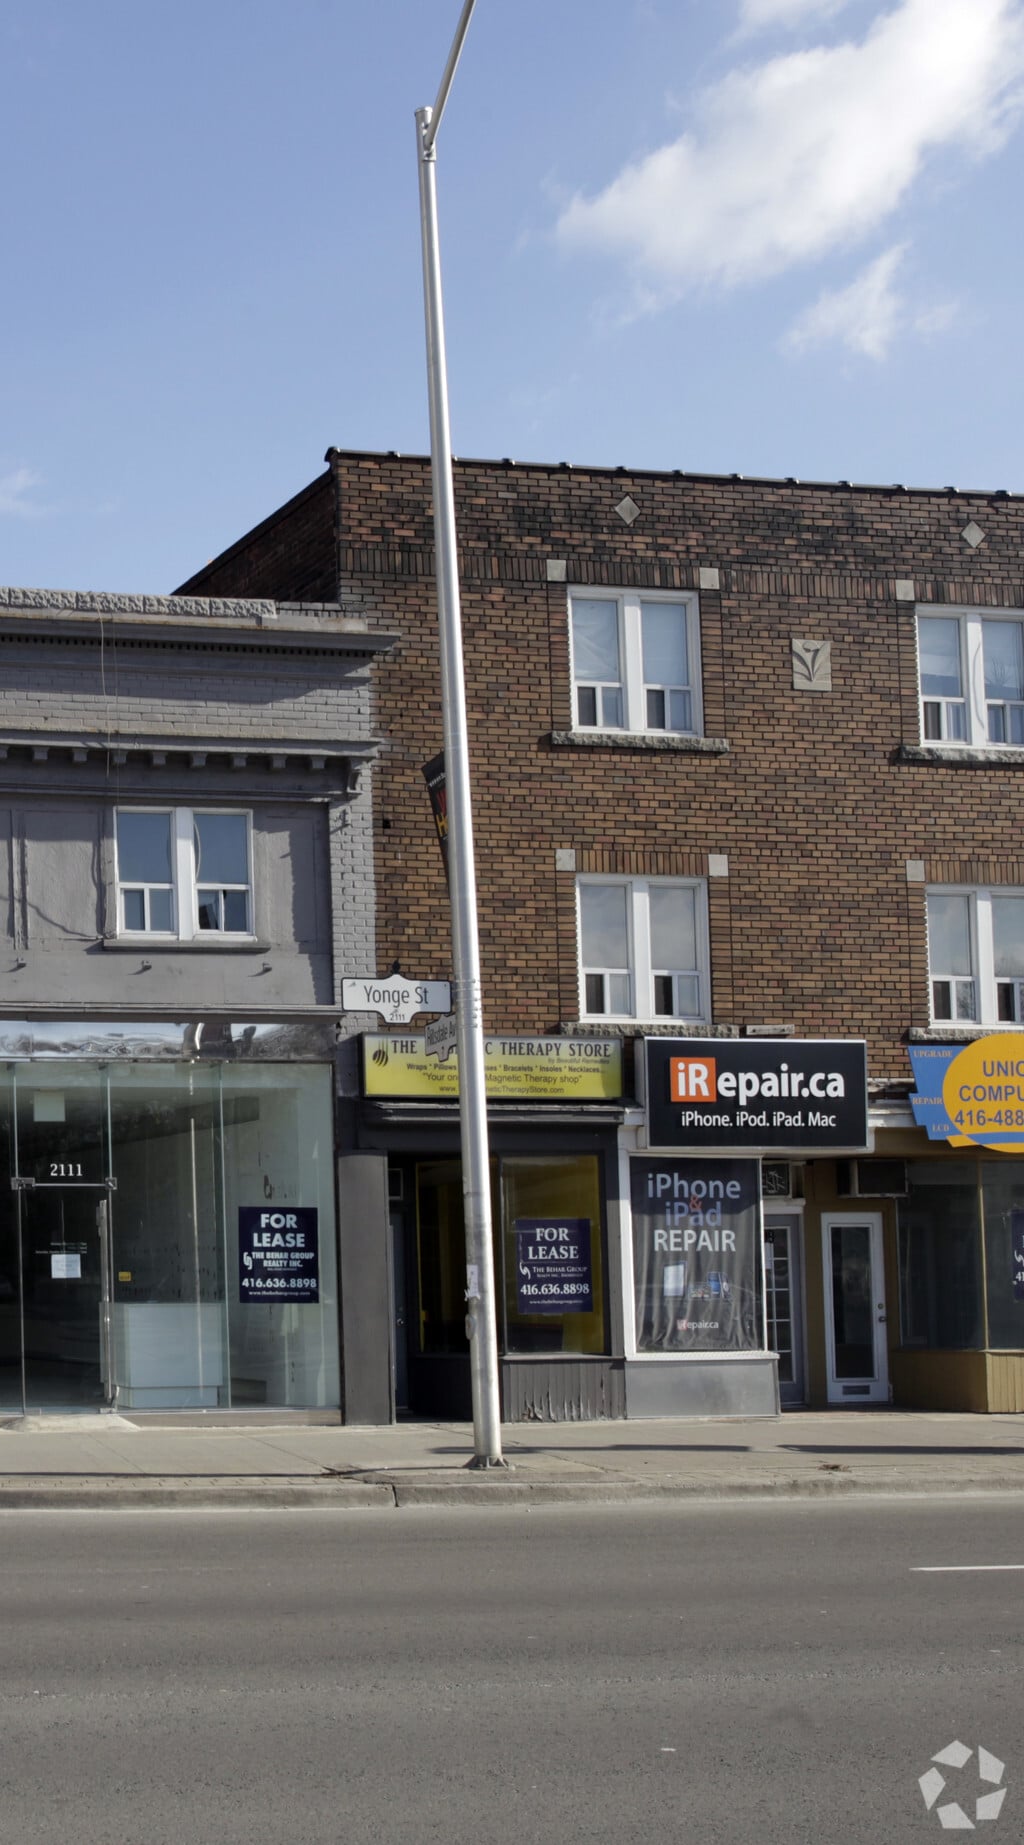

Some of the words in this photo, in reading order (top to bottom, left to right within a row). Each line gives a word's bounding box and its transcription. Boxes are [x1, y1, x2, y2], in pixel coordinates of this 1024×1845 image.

[364, 985, 410, 1008] Yonge
[415, 986, 429, 1004] St
[389, 1012, 406, 1021] 2111
[392, 1040, 418, 1054] THE
[500, 1041, 562, 1056] THERAPY
[569, 1043, 611, 1057] STORE
[913, 1050, 953, 1058] UPGRADE
[407, 1063, 427, 1071] Wraps
[503, 1064, 533, 1072] Bracelets
[524, 1074, 558, 1085] Therapy
[677, 1062, 845, 1106] iRepair.ca
[959, 1084, 1024, 1102] COMPU
[681, 1110, 733, 1127] iPhone.
[736, 1110, 770, 1127] iPod.
[773, 1110, 805, 1127] iPad.
[808, 1112, 837, 1127] Mac
[954, 1109, 1024, 1127] 416-488
[932, 1123, 950, 1132] LCD
[50, 1163, 83, 1177] 2111
[647, 1173, 742, 1199] iPhone
[260, 1213, 297, 1229] FOR
[665, 1201, 722, 1227] iPad
[253, 1232, 305, 1247] LEASE
[535, 1227, 570, 1242] FOR
[653, 1229, 736, 1252] REPAIR
[266, 1252, 289, 1260] BEHAR
[290, 1252, 314, 1260] GROUP
[527, 1245, 579, 1260] LEASE
[263, 1259, 288, 1267] REALTY
[289, 1260, 304, 1268] INC.
[242, 1278, 317, 1288] 416.636.8898
[520, 1283, 590, 1296] 416.636.8898
